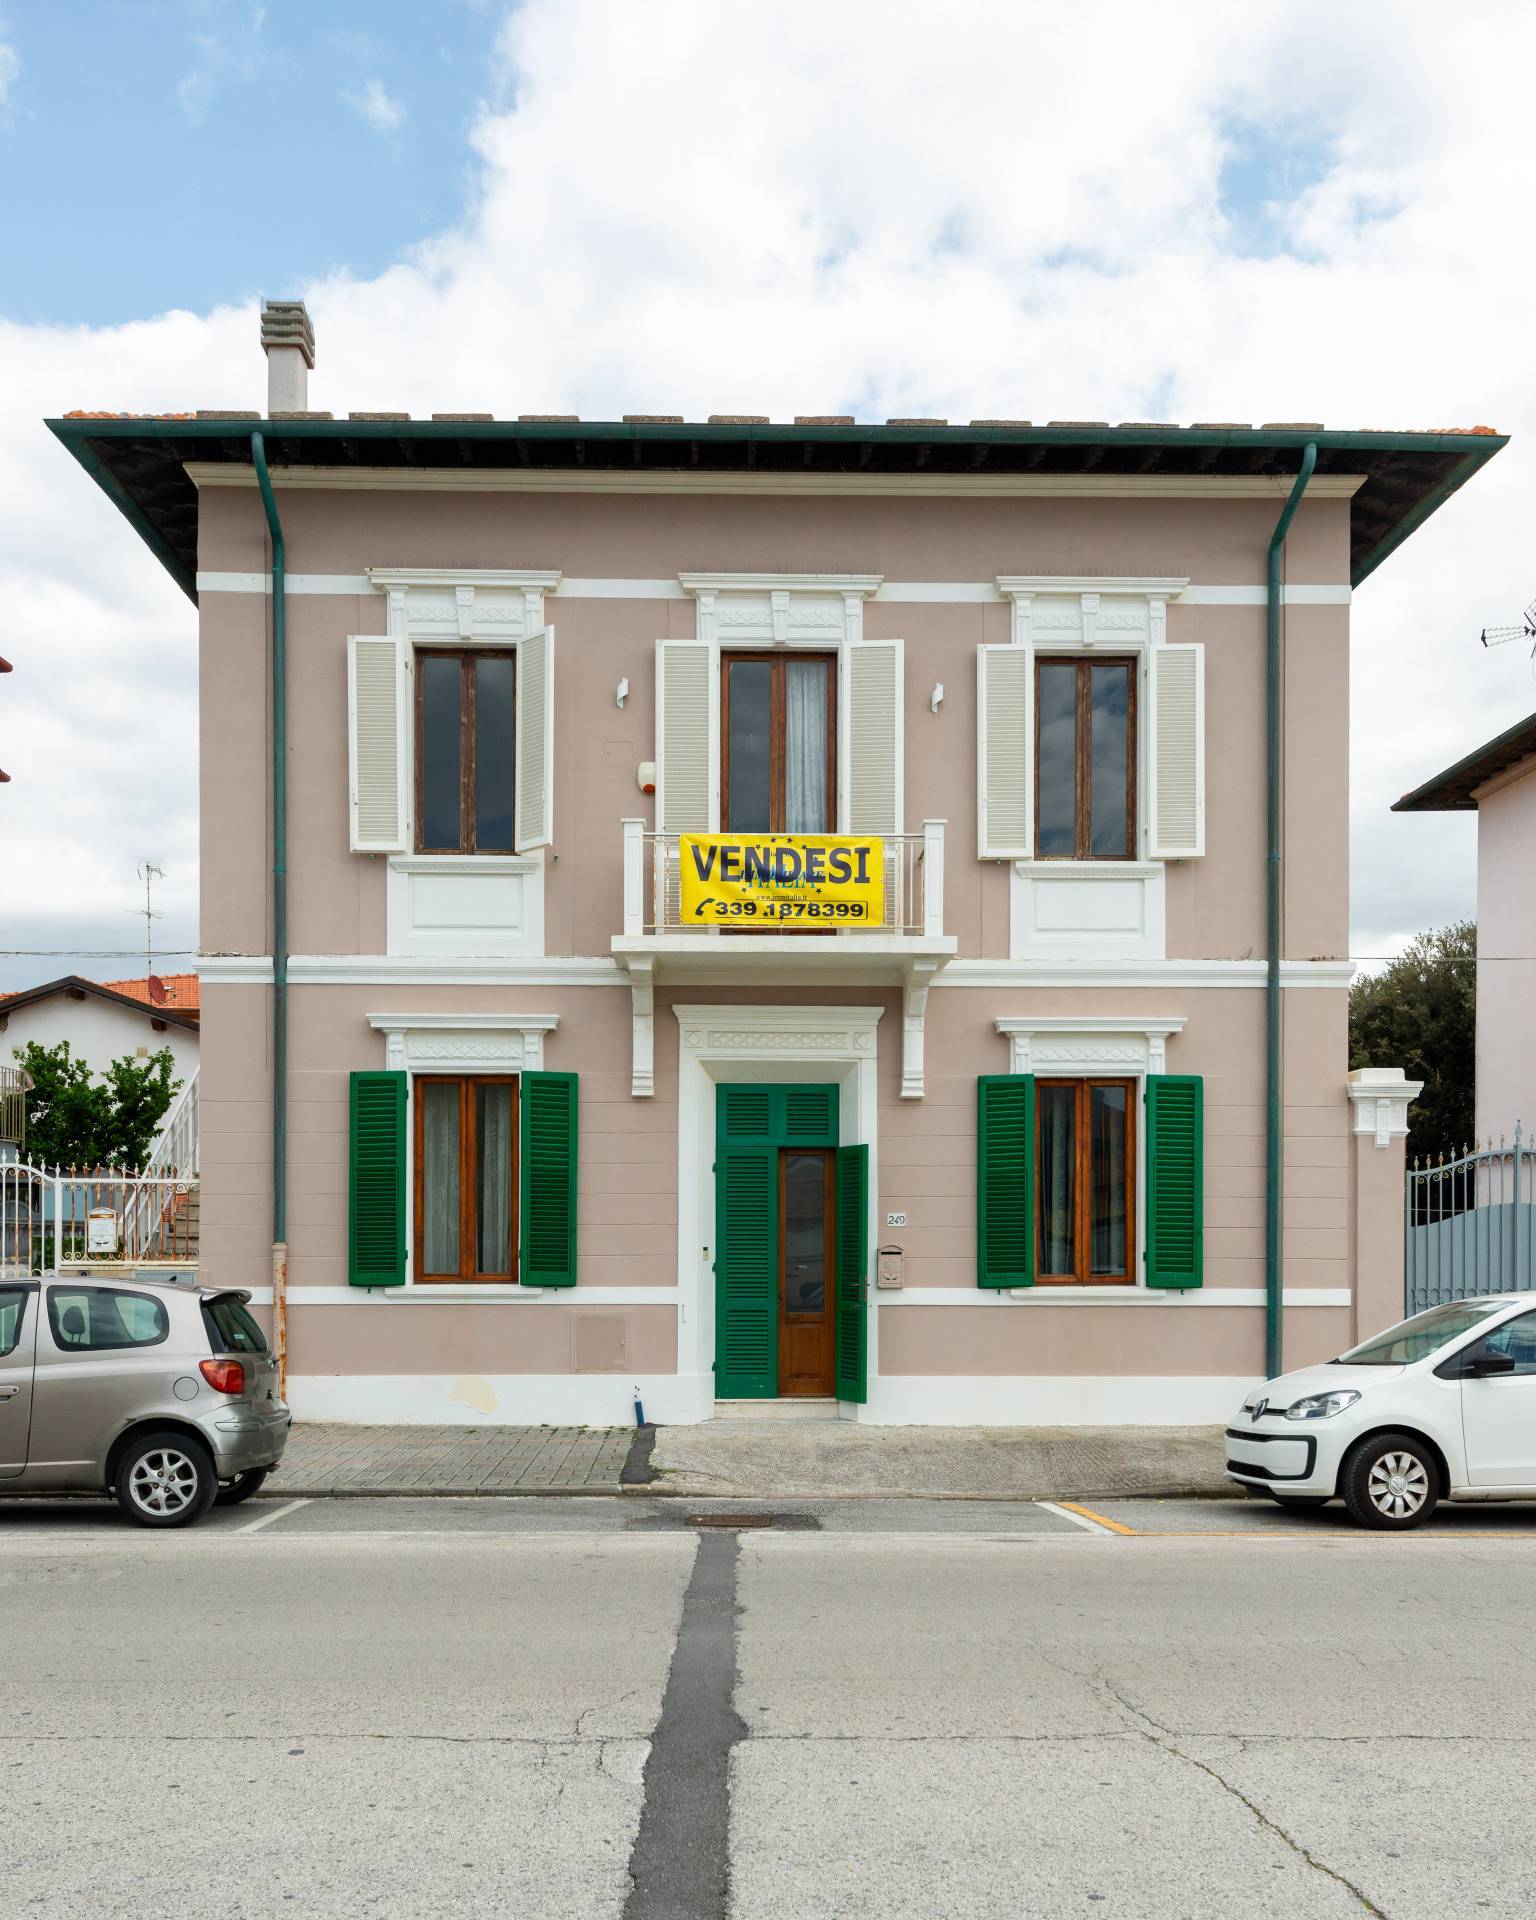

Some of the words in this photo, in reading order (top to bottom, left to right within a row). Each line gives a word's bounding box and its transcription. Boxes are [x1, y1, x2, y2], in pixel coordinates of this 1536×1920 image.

[692, 845, 871, 883] VENDESI
[715, 902, 757, 916] 339
[888, 1215, 905, 1225] 249
